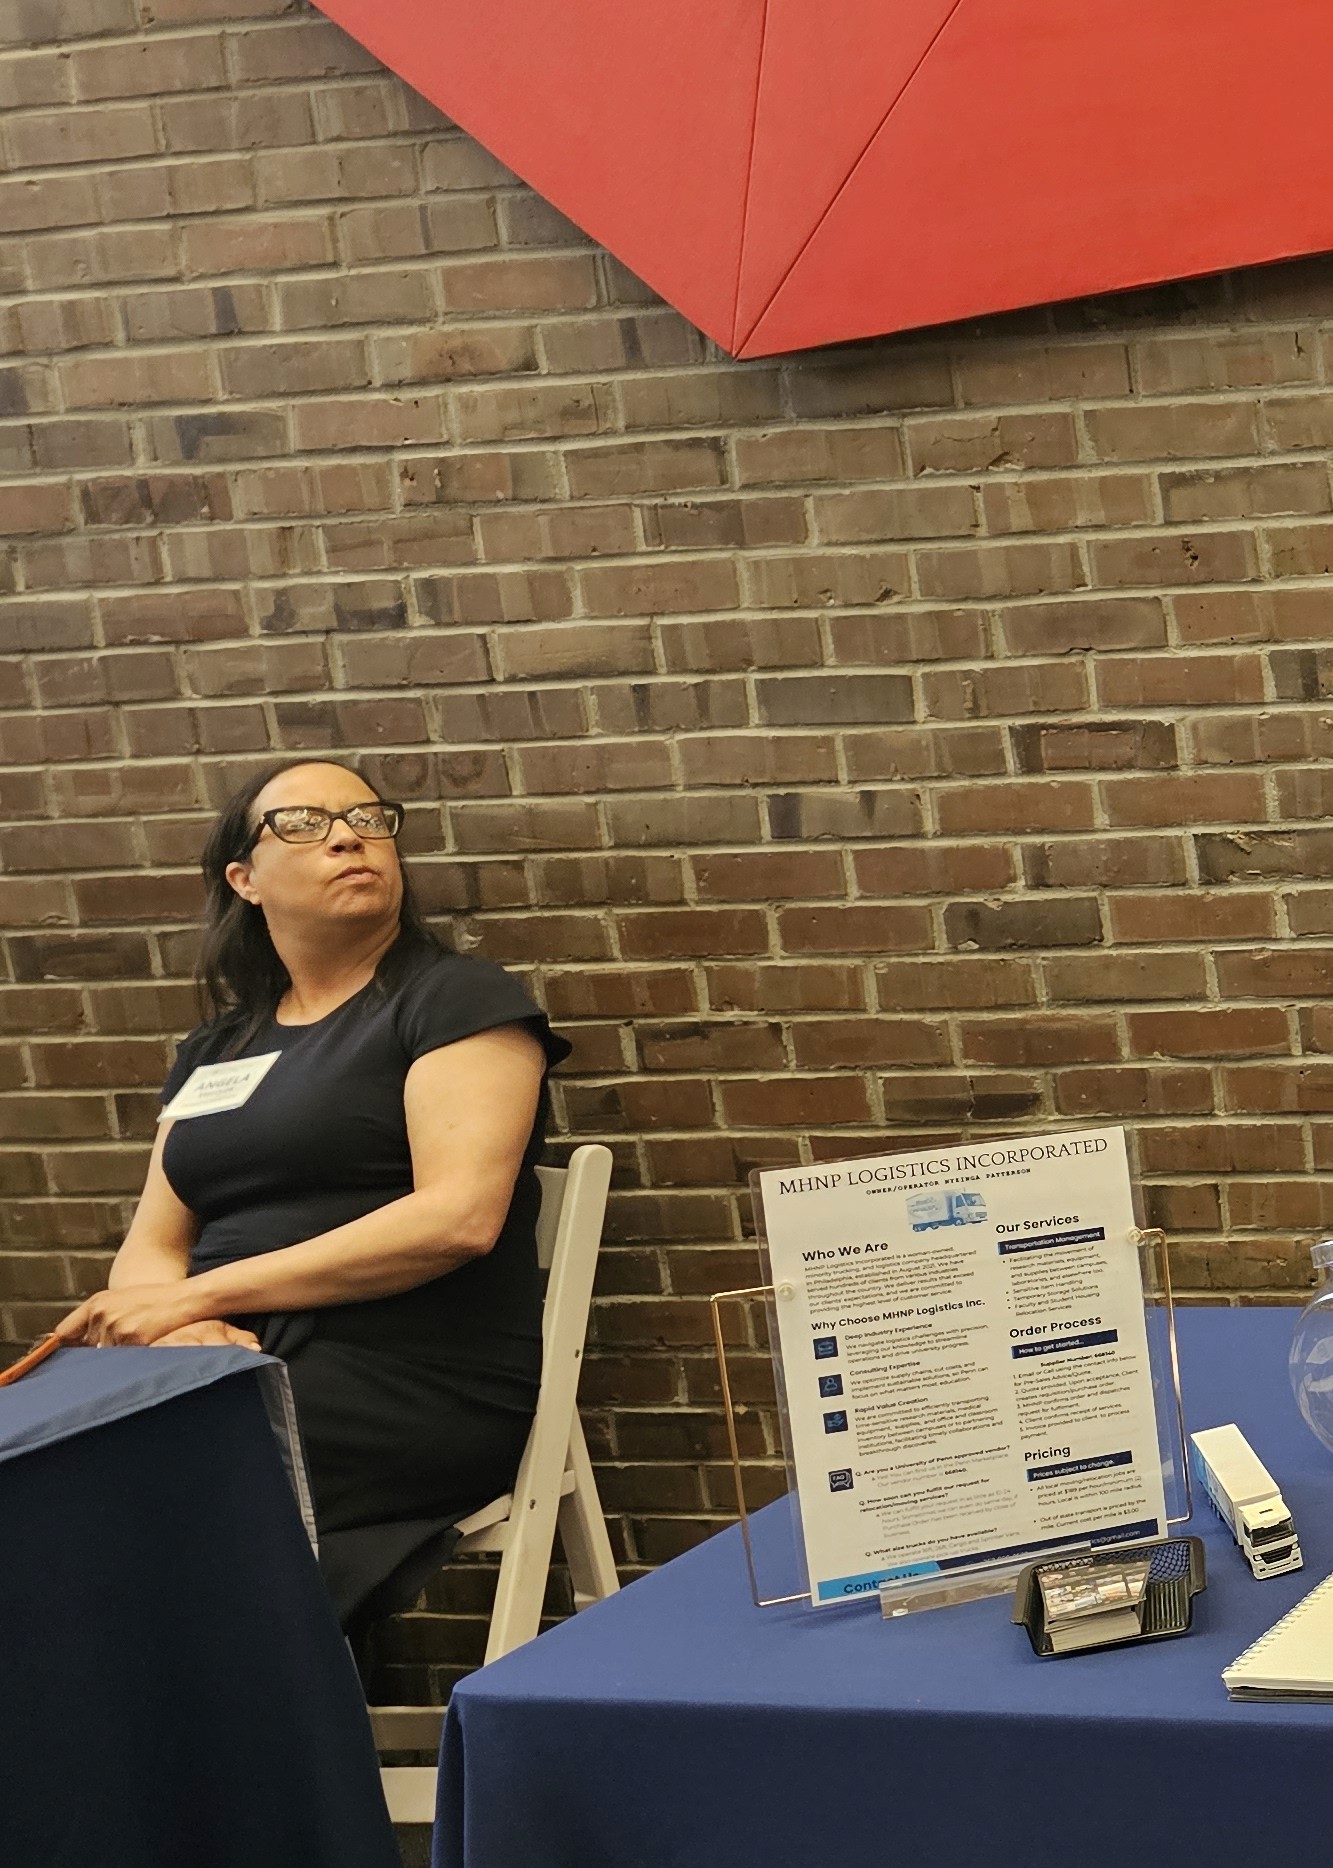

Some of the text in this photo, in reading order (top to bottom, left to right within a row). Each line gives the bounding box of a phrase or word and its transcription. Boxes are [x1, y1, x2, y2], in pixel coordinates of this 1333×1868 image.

[778, 1138, 1108, 1195] MHNP LOGISTICS INCORPORATED
[995, 1215, 1079, 1234] Our Services
[1004, 1231, 1100, 1250] Transportation Management
[801, 1242, 888, 1262] Who We Are
[810, 1299, 985, 1331] Why Choose MHNP Logistics Inc.
[1008, 1316, 1102, 1338] Order Process
[1042, 1343, 1054, 1352] get
[1055, 1338, 1084, 1348] started...
[1024, 1446, 1071, 1462] Pricing
[843, 1574, 898, 1594] Cont
